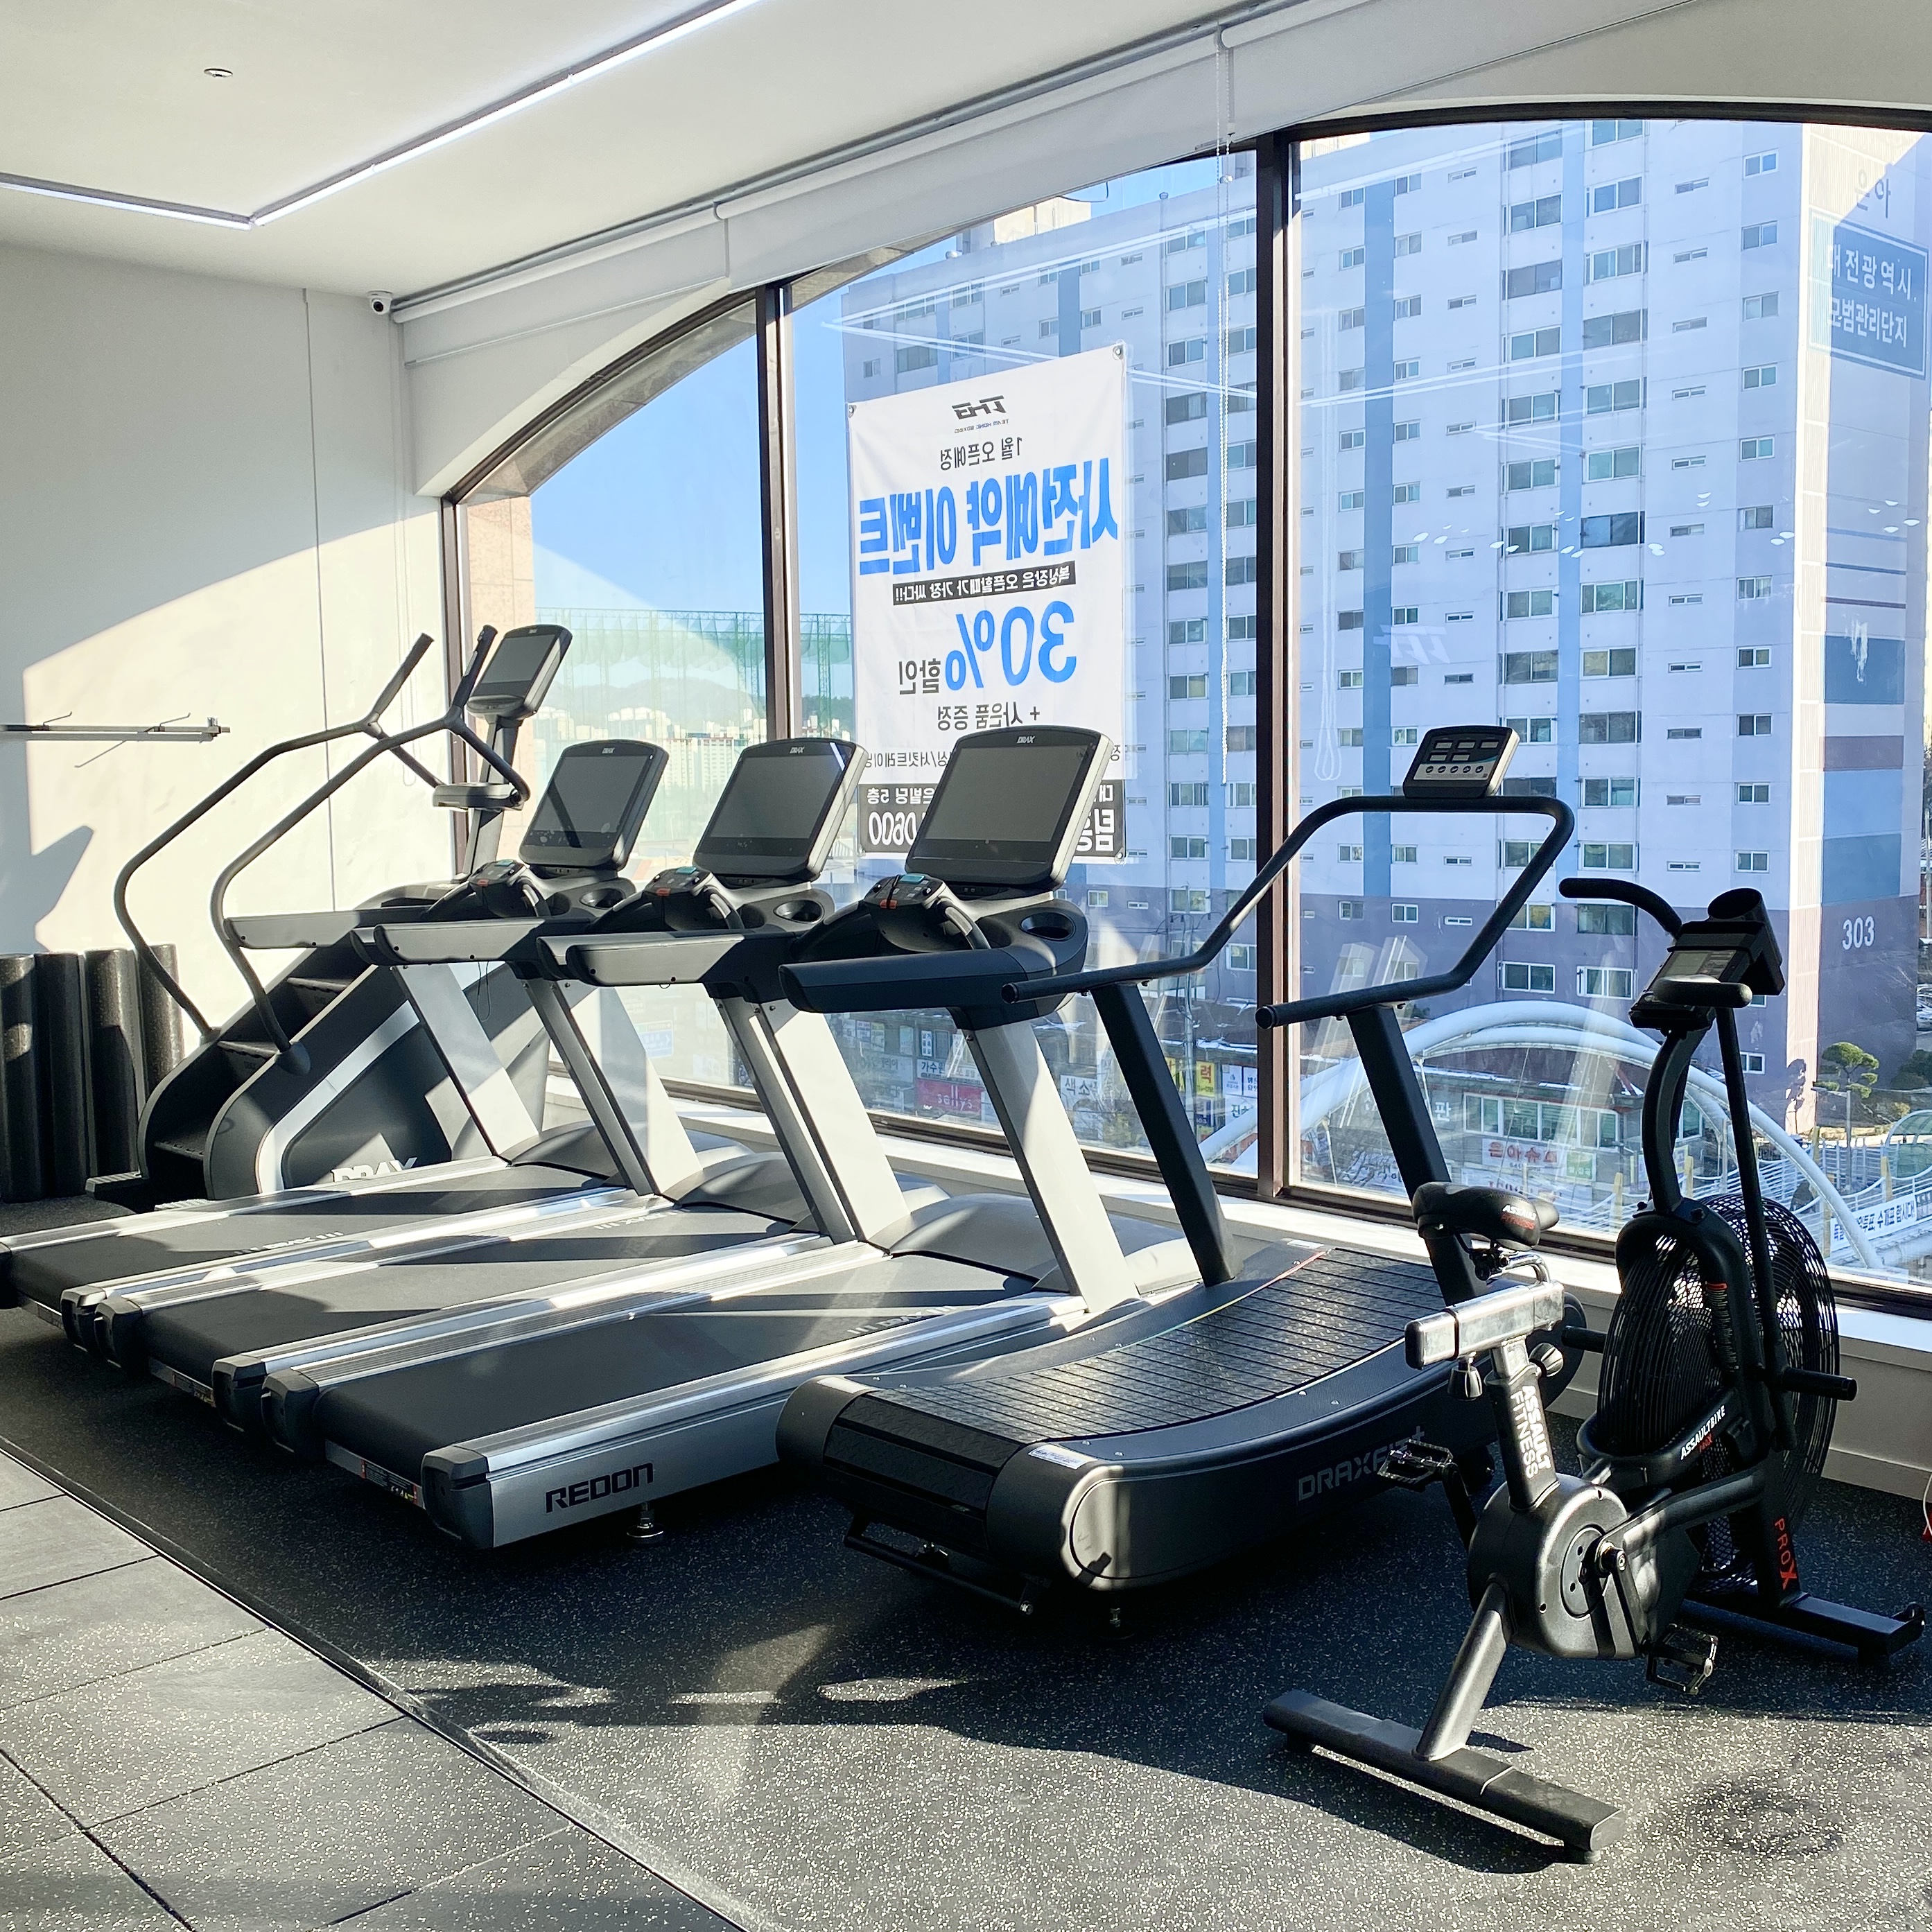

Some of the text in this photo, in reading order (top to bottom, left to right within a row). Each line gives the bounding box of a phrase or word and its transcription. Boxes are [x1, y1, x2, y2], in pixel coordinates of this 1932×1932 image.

[1016, 736, 1036, 744] DRAX
[1842, 916, 1874, 950] 303
[1502, 1204, 1537, 1221] ASSAULT
[1510, 1391, 1539, 1479] FITNESS
[1522, 1386, 1551, 1470] ASSAULT
[546, 1462, 654, 1513] REDON
[1775, 1517, 1798, 1591] PROX
